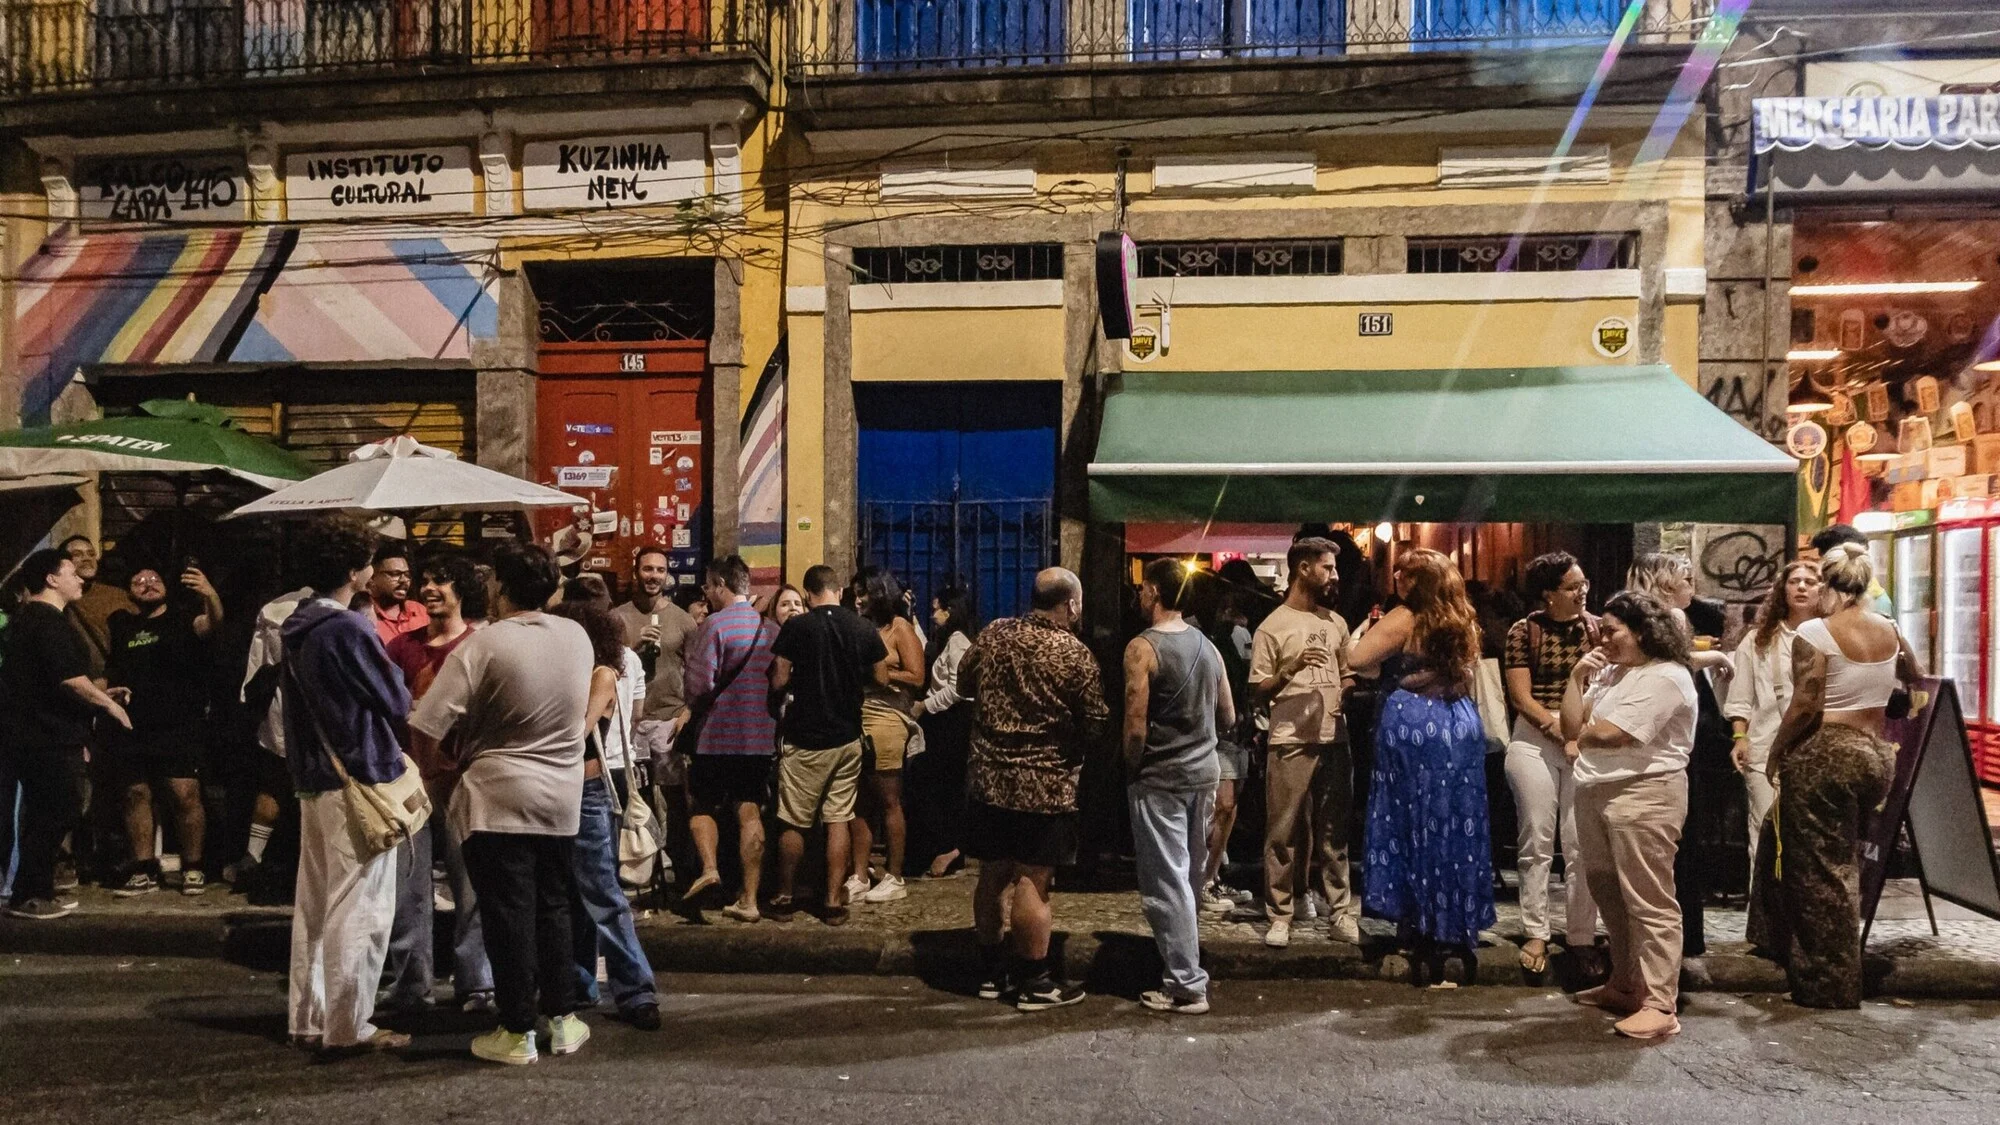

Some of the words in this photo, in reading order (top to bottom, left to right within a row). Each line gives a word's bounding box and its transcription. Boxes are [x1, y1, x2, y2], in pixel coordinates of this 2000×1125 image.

[1759, 97, 1932, 138] MERCEARIA
[307, 153, 444, 181] INSTITUTO
[557, 142, 671, 174] KUZINHA
[108, 186, 172, 220] LAPA
[181, 166, 238, 211] 145
[330, 178, 432, 207] CULTURAL
[587, 173, 648, 200] NEM
[1363, 315, 1389, 332] 151
[623, 354, 645, 370] 145
[70, 434, 171, 452] SPATEN
